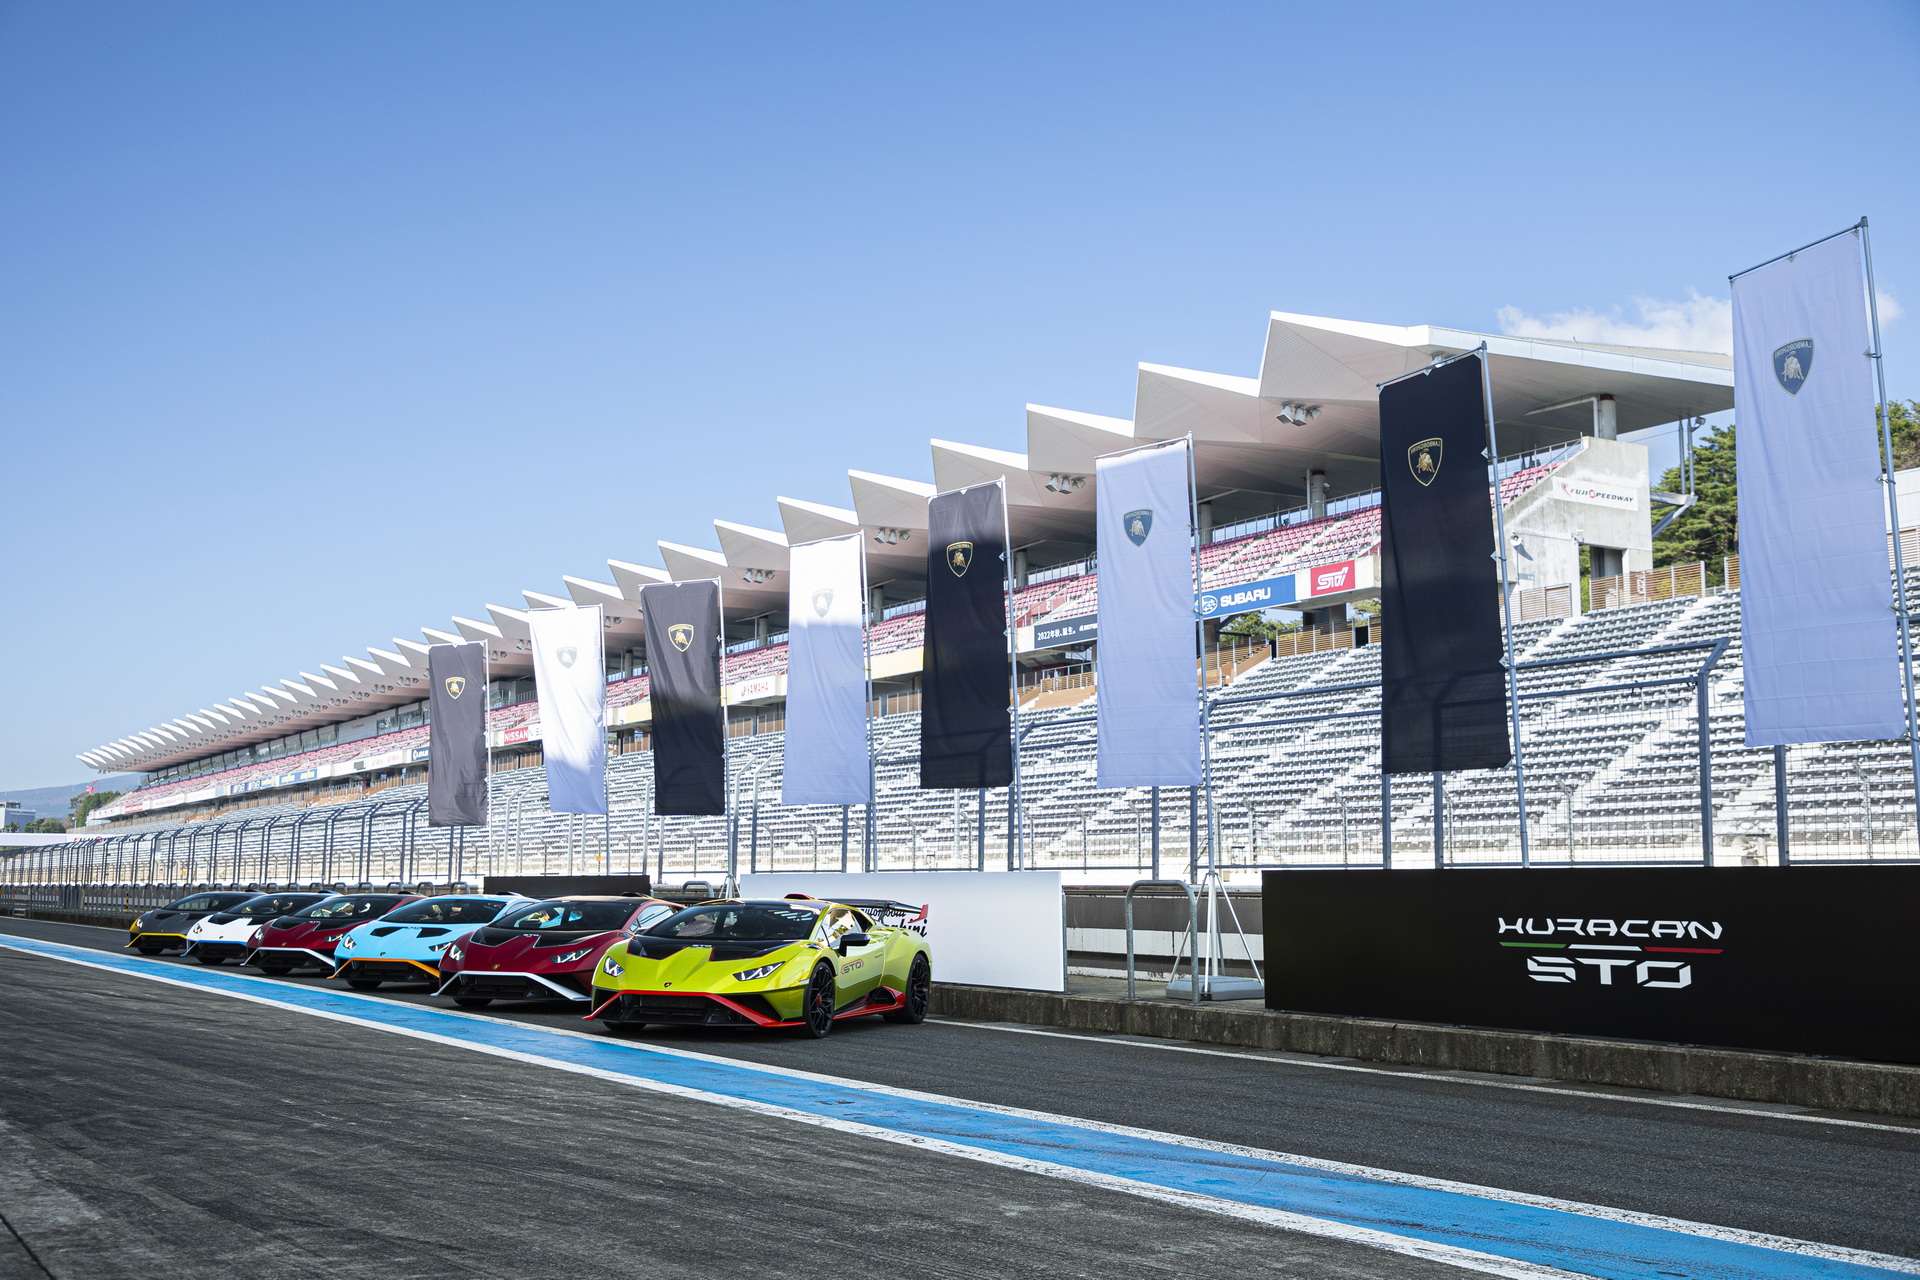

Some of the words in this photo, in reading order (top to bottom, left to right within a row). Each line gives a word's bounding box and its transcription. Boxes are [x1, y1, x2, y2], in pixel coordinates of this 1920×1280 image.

[1570, 488, 1588, 496] FUJI
[1588, 489, 1634, 502] SPEEDWAY
[1220, 587, 1271, 608] SUBARU
[504, 729, 528, 744] NISSAN
[843, 961, 862, 974] STO
[1526, 955, 1692, 989] STO
